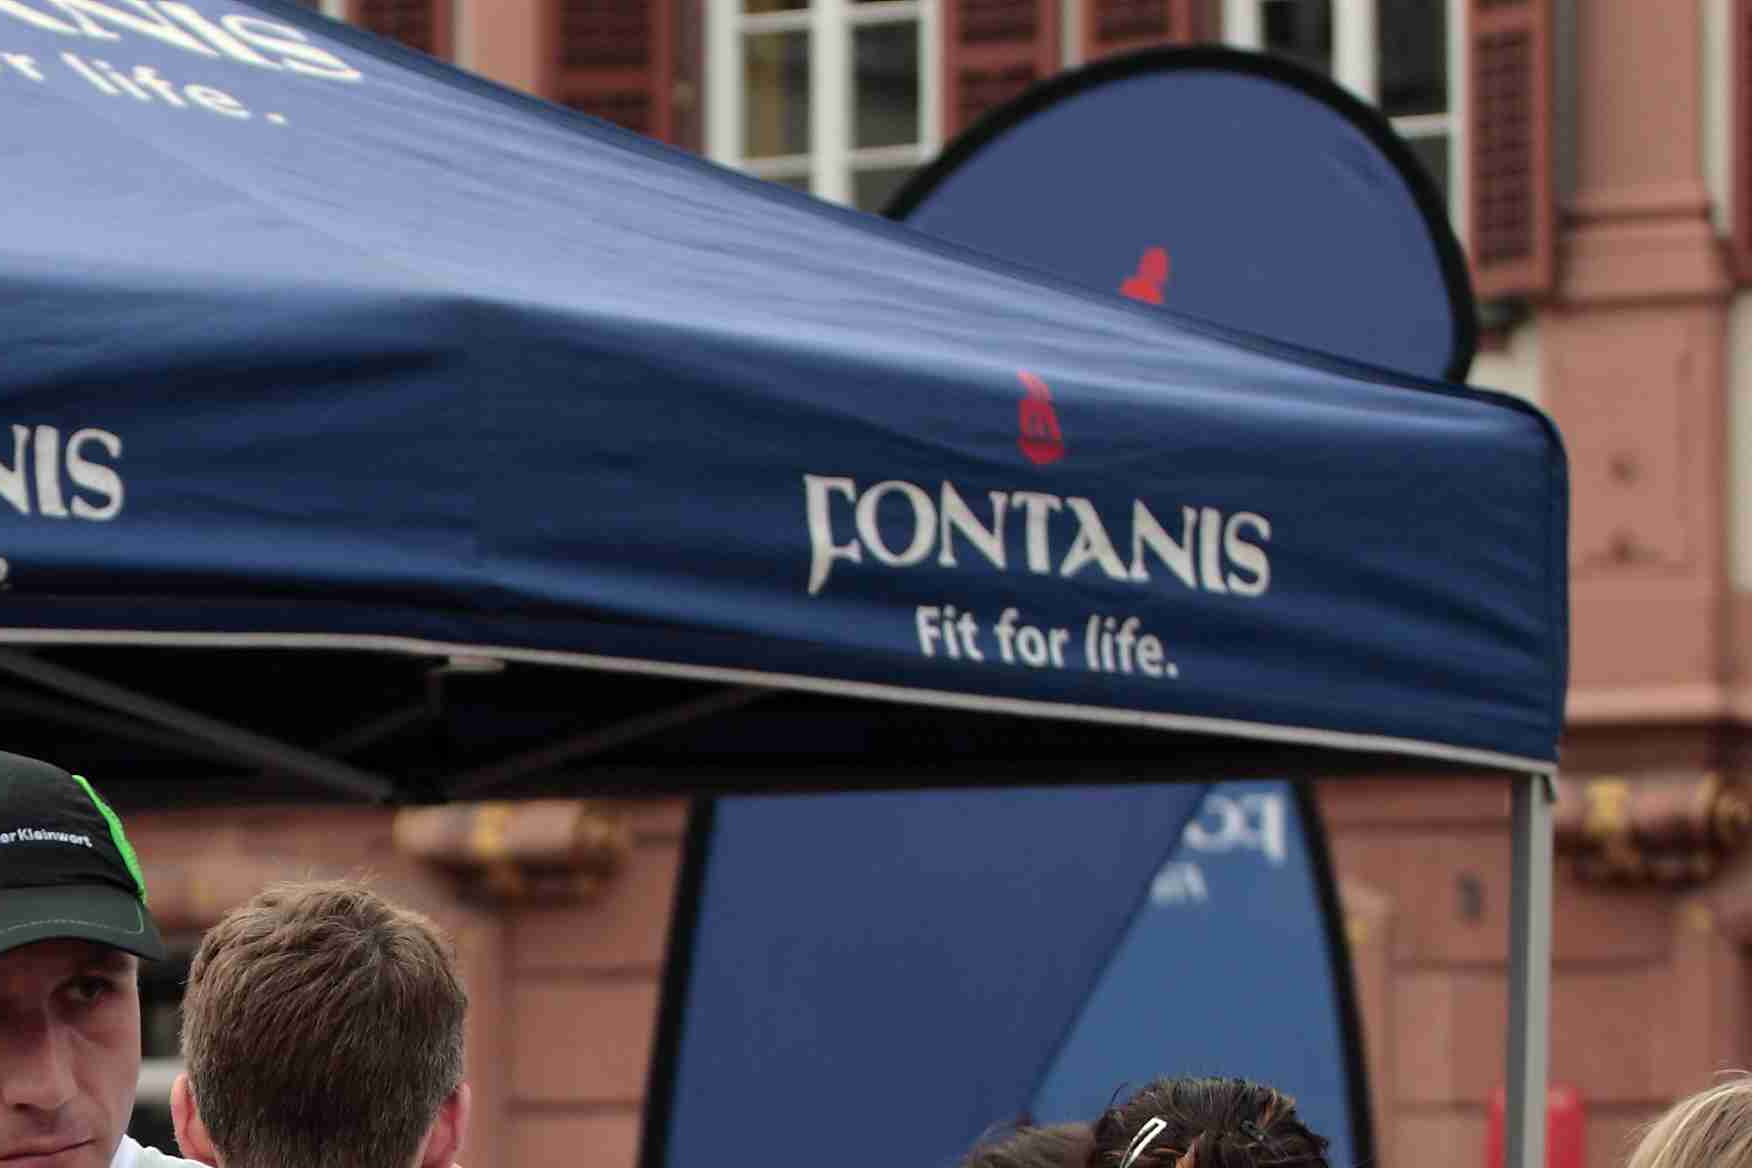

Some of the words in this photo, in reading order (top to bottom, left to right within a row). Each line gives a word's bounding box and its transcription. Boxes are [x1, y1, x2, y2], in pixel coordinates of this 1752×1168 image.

[60, 51, 289, 126] life.
[803, 473, 1271, 597] FONTANIS
[915, 604, 984, 661] Fit
[993, 607, 1070, 669] for
[1084, 613, 1179, 679] life.
